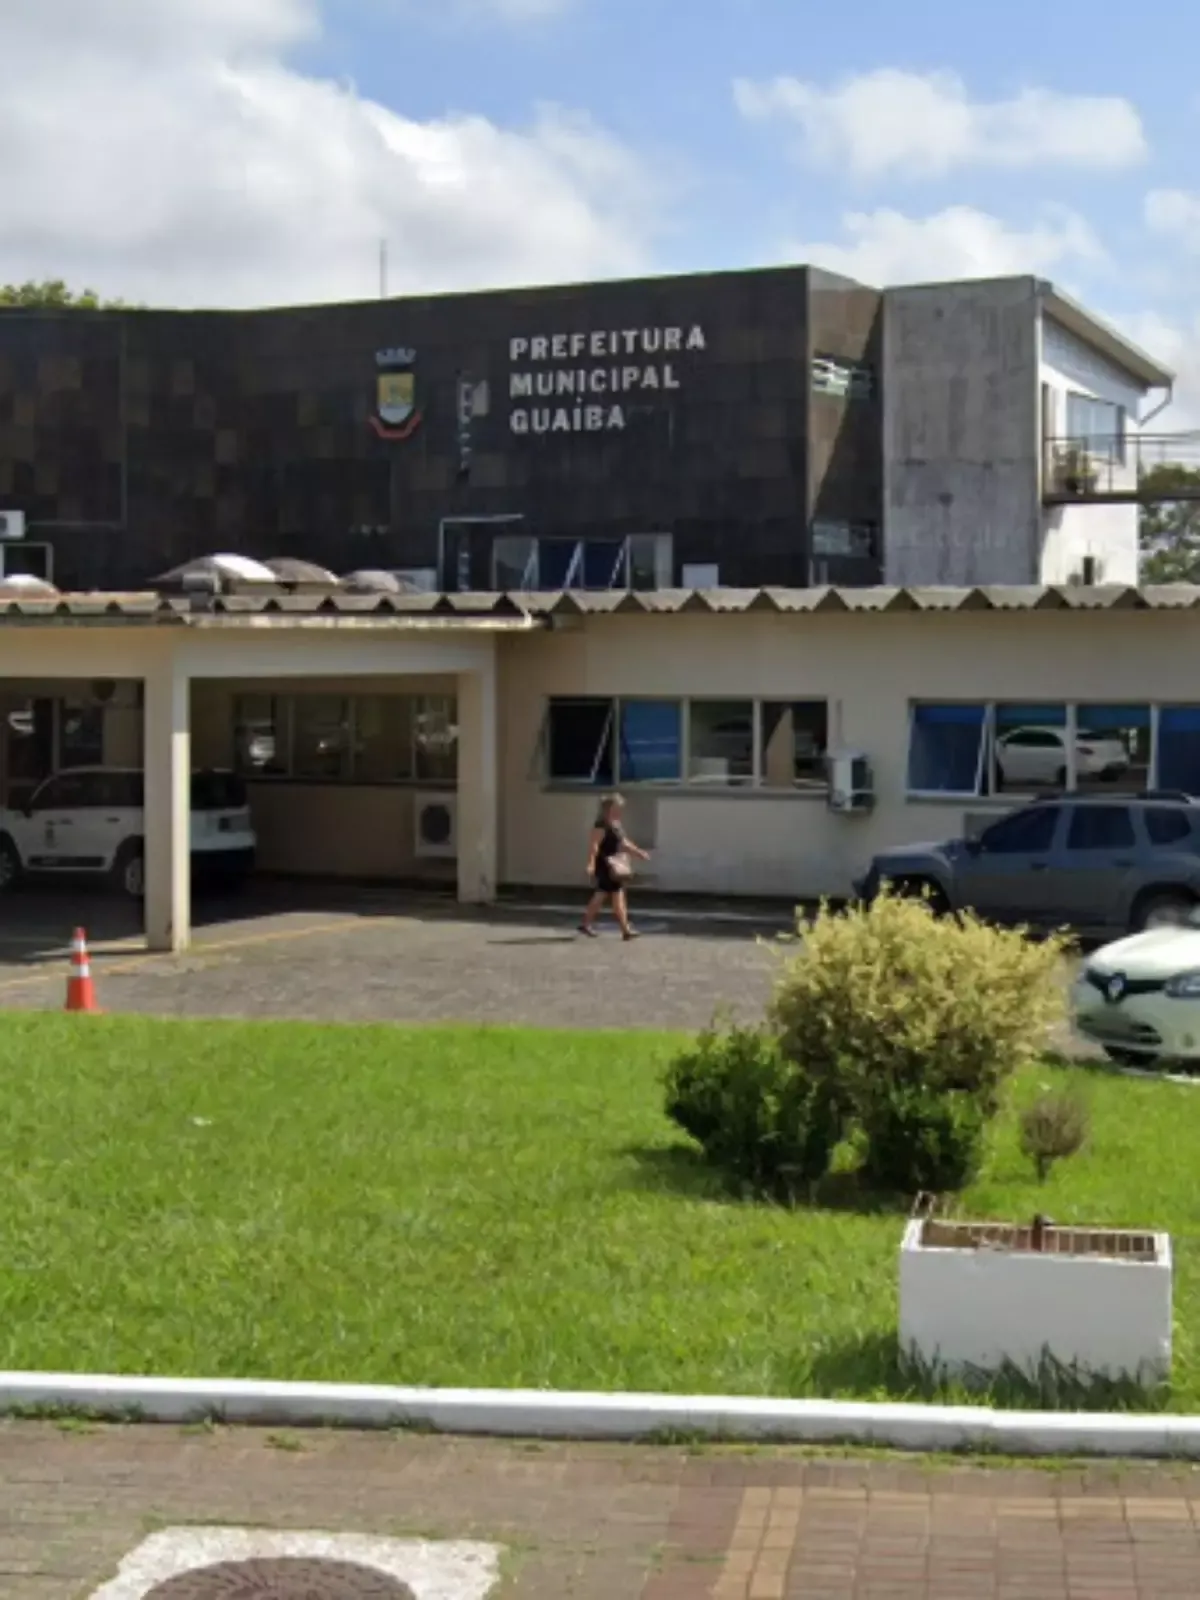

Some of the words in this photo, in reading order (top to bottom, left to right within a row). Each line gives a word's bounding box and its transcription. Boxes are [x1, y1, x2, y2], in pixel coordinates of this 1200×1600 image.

[509, 325, 706, 361] PREFEITURA
[509, 364, 680, 396] MUNICIPAL
[509, 397, 626, 434] GUAÍBA
